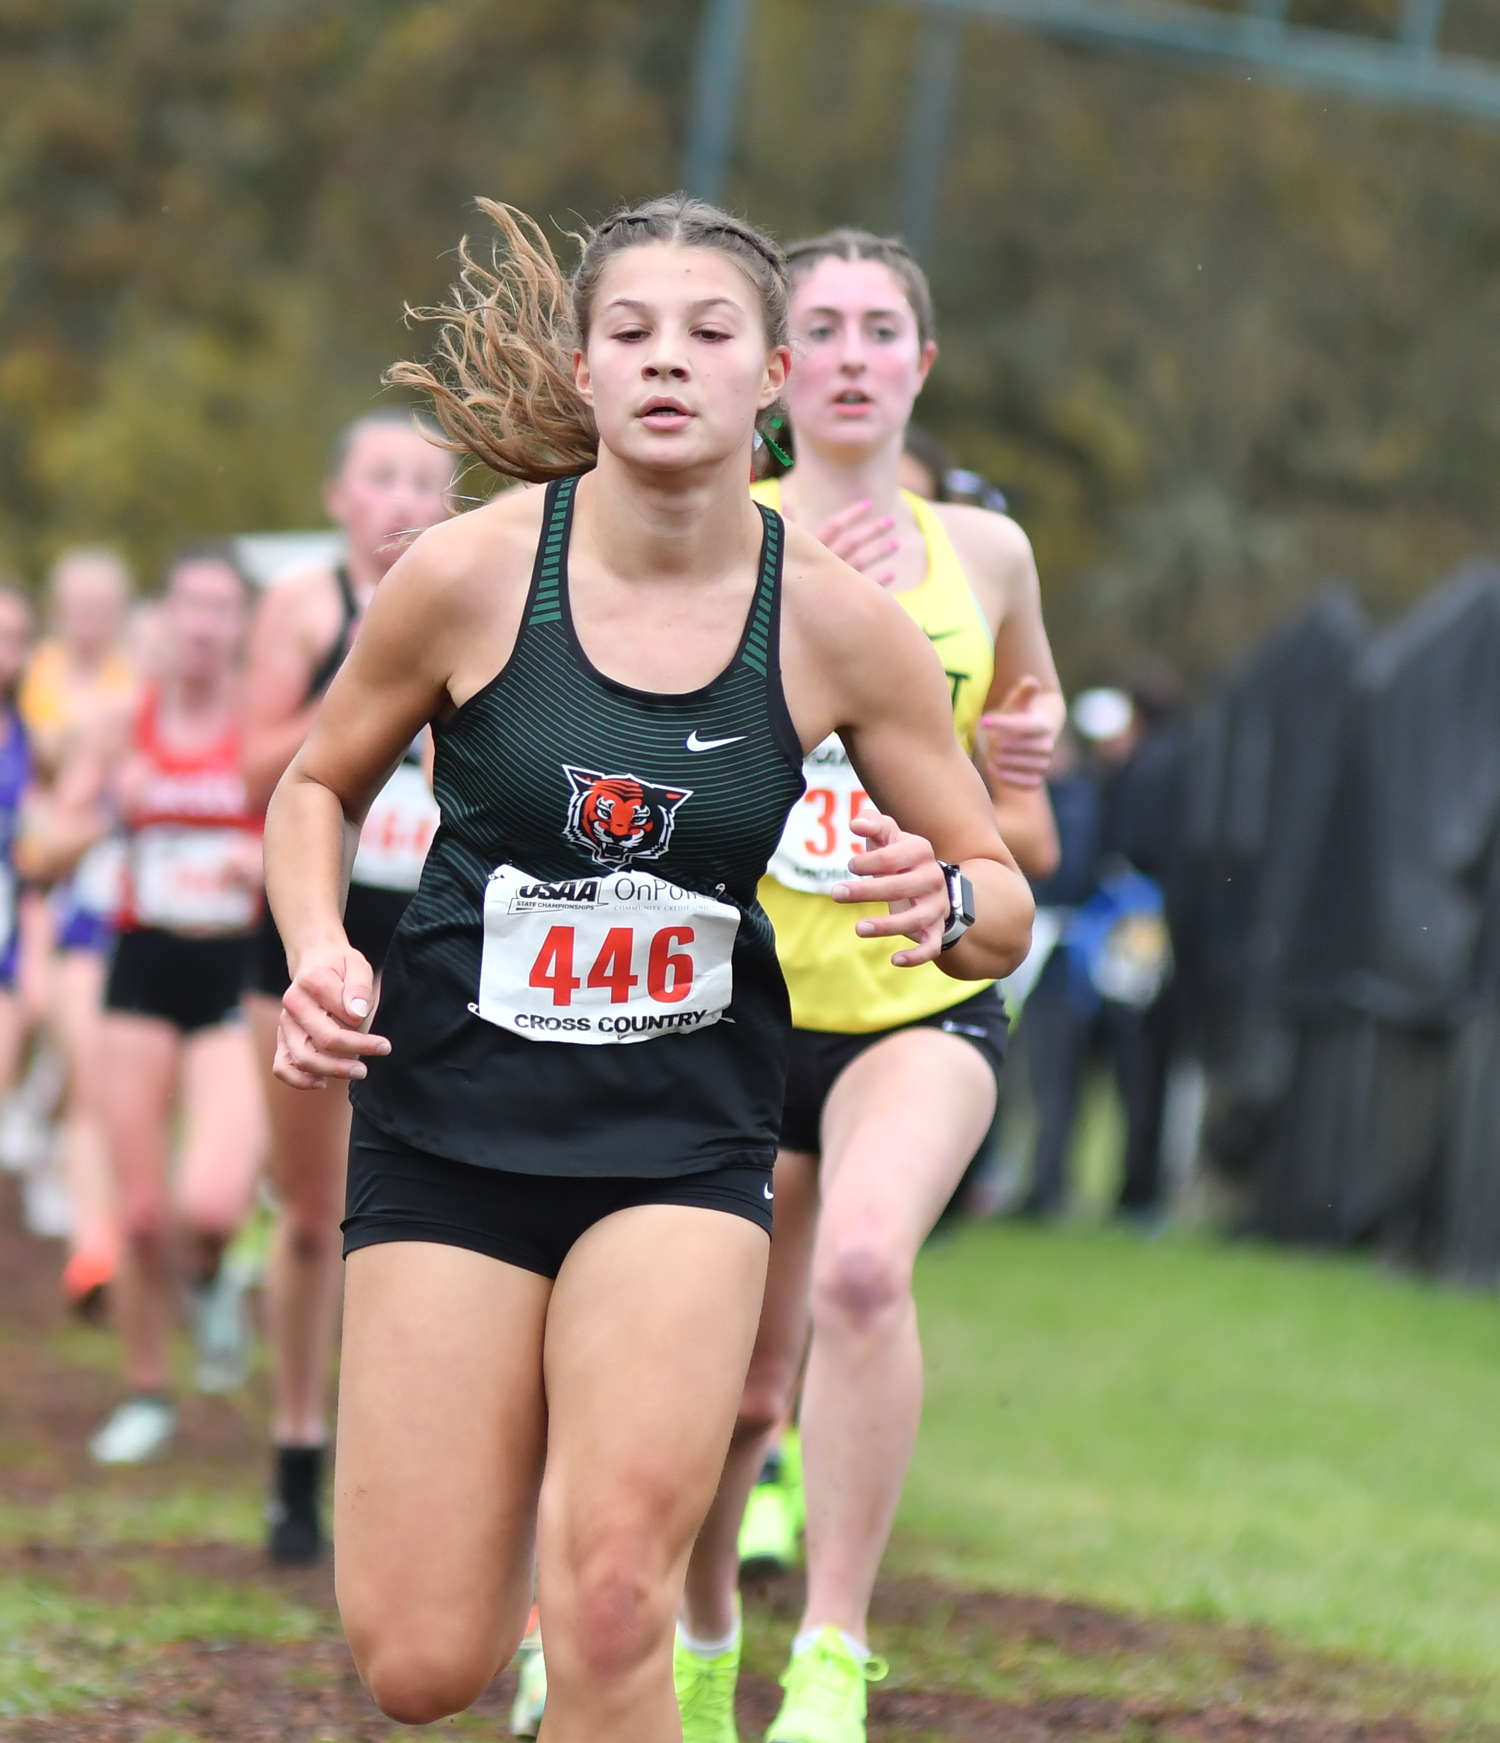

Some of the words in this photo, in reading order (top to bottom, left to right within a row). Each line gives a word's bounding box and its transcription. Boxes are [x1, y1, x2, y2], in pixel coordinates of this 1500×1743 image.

[516, 900, 537, 908] STATE
[537, 902, 595, 911] CHAMPIONSHIPS
[529, 925, 695, 1006] 446
[514, 1013, 591, 1032] CROSS
[597, 1009, 708, 1034] COUNTRY
